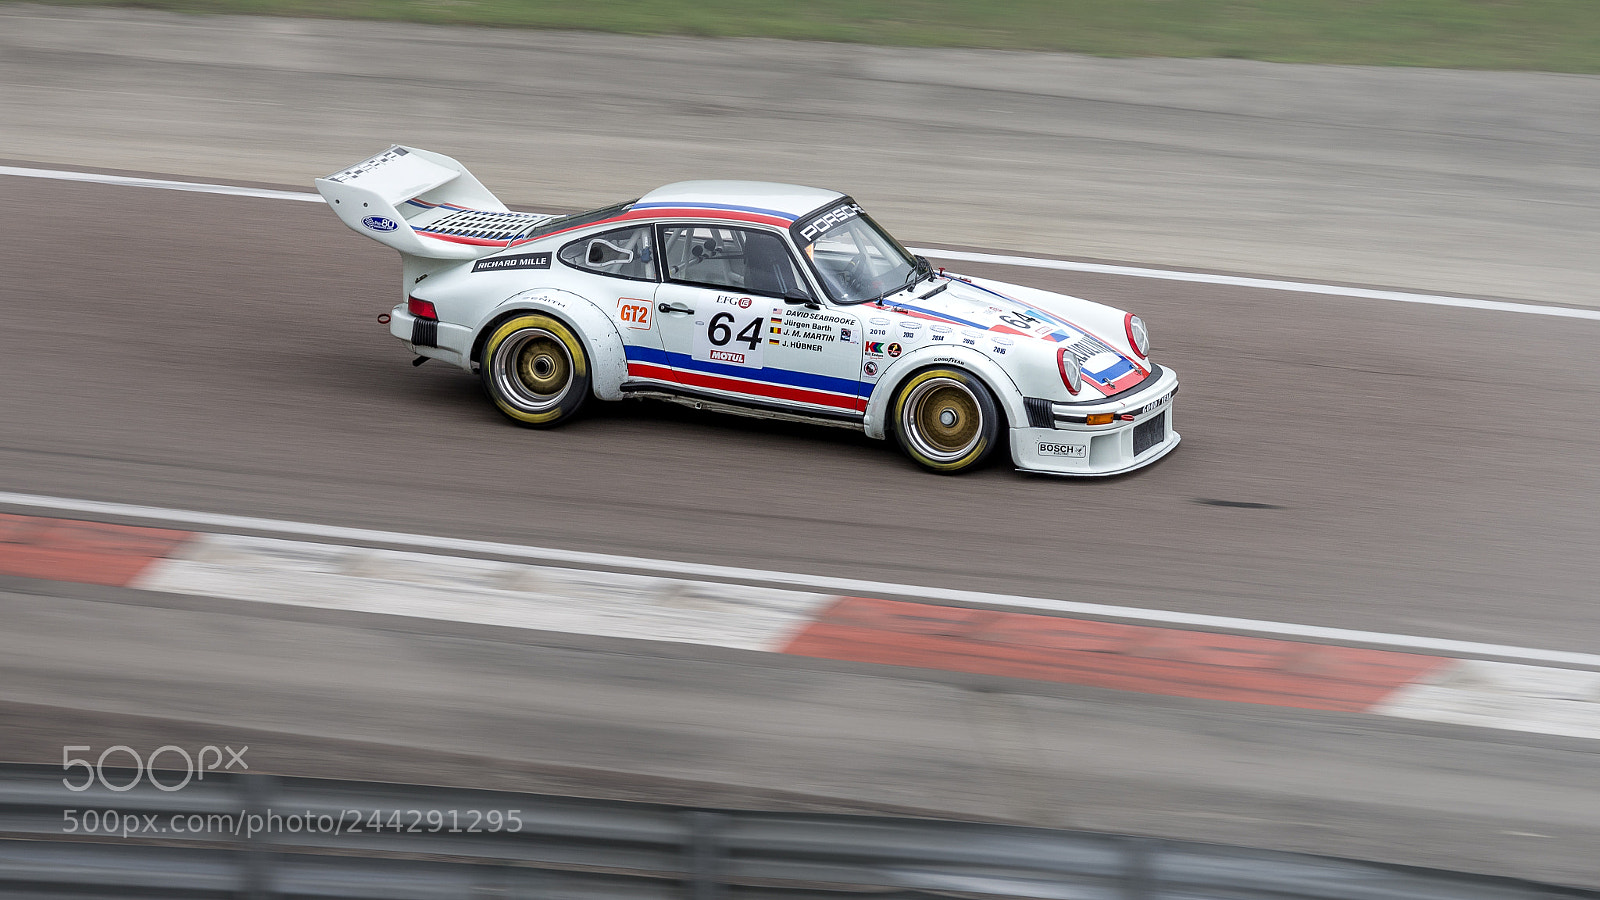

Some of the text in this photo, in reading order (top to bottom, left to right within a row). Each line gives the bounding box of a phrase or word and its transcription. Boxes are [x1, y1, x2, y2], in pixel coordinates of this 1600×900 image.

[478, 257, 547, 269] RICHARD MILLE
[716, 295, 738, 306] EFG
[620, 304, 648, 323] GT2
[785, 309, 809, 319] DAVID
[809, 313, 856, 326] SEABROOKE
[999, 306, 1041, 329] 64
[707, 312, 764, 350] 64
[784, 319, 832, 332] Jürgen Barth
[791, 330, 801, 338] M.
[803, 331, 835, 342] MARTIN
[869, 328, 886, 336] 2010
[790, 341, 823, 352] HÜBNER
[711, 351, 744, 363] MOTUL
[1040, 444, 1074, 453] BOSCH
